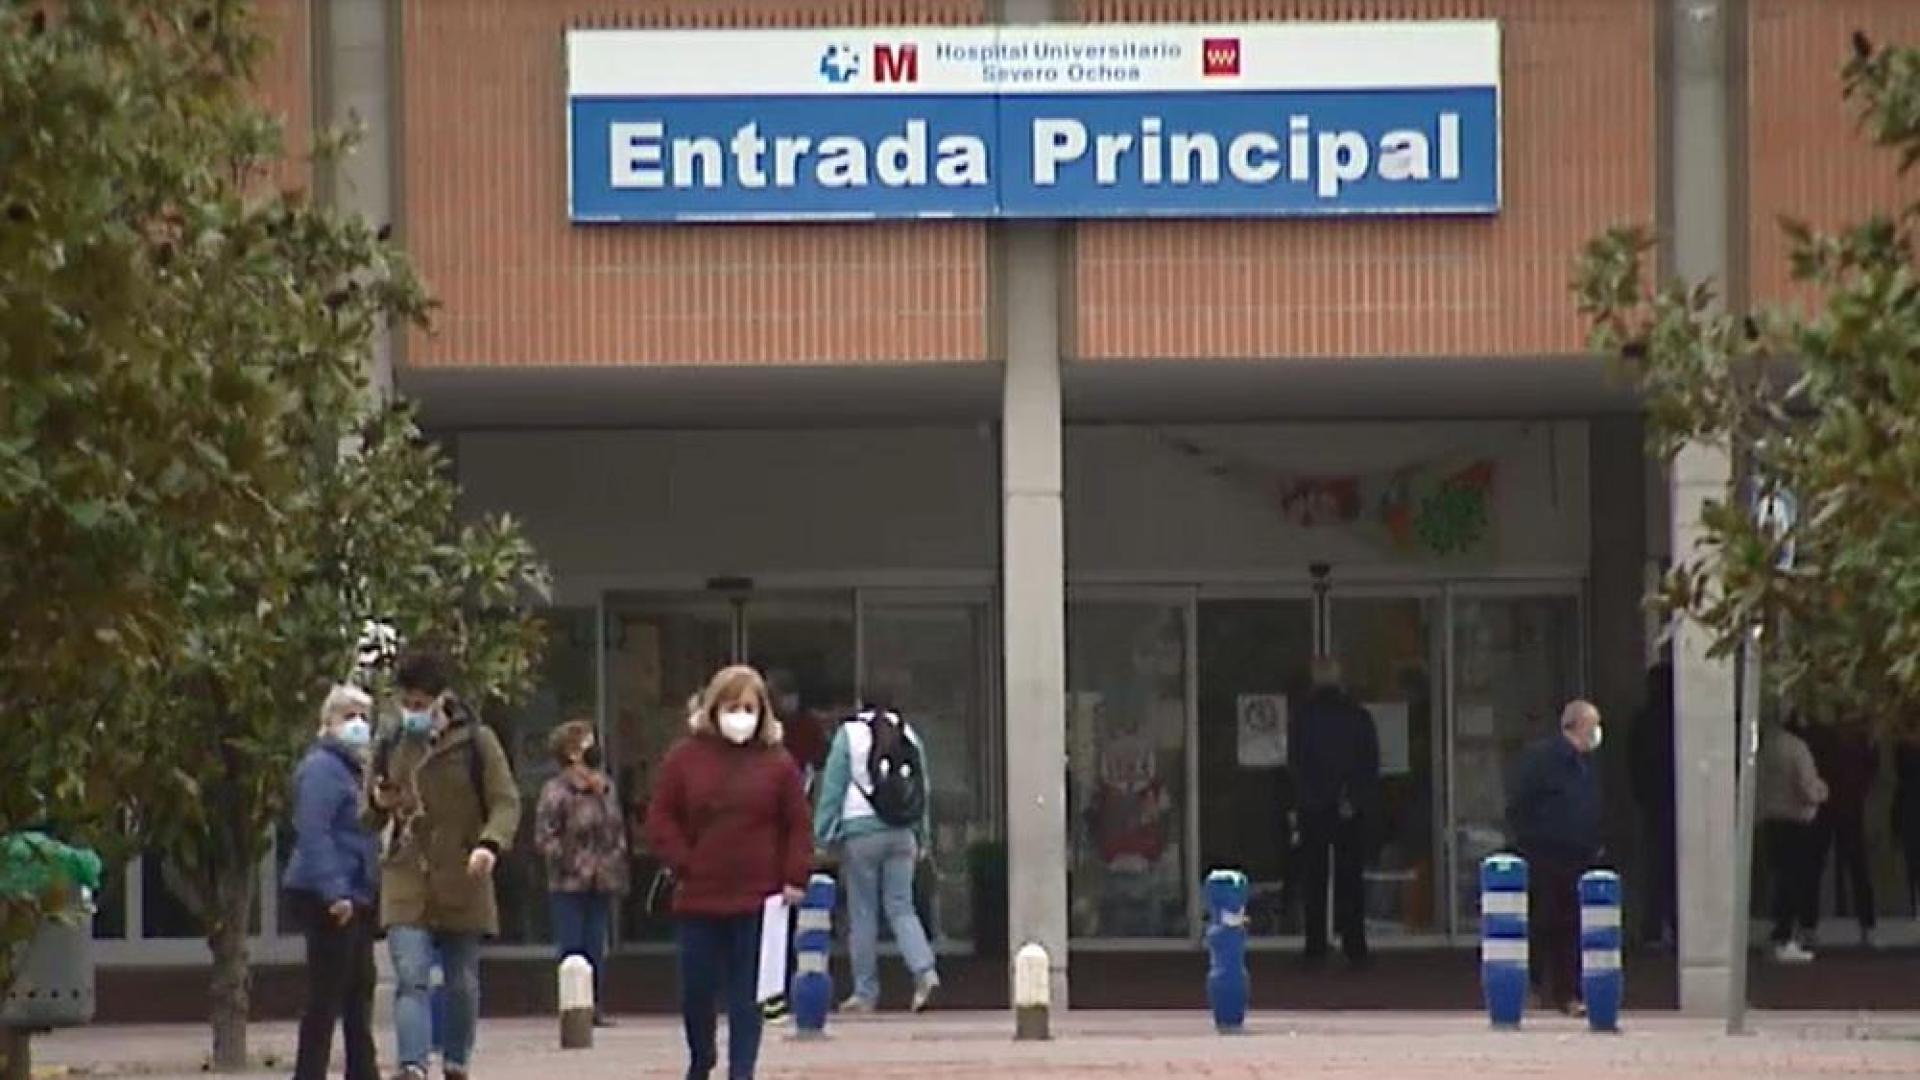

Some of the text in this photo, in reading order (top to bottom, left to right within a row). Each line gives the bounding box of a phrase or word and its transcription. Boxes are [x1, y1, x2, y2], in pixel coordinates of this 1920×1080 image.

[873, 44, 918, 83] M
[936, 40, 1182, 62] Hospital Universitario
[982, 64, 1141, 82] Severo Ochoa
[609, 112, 1461, 197] Entrada Principal
